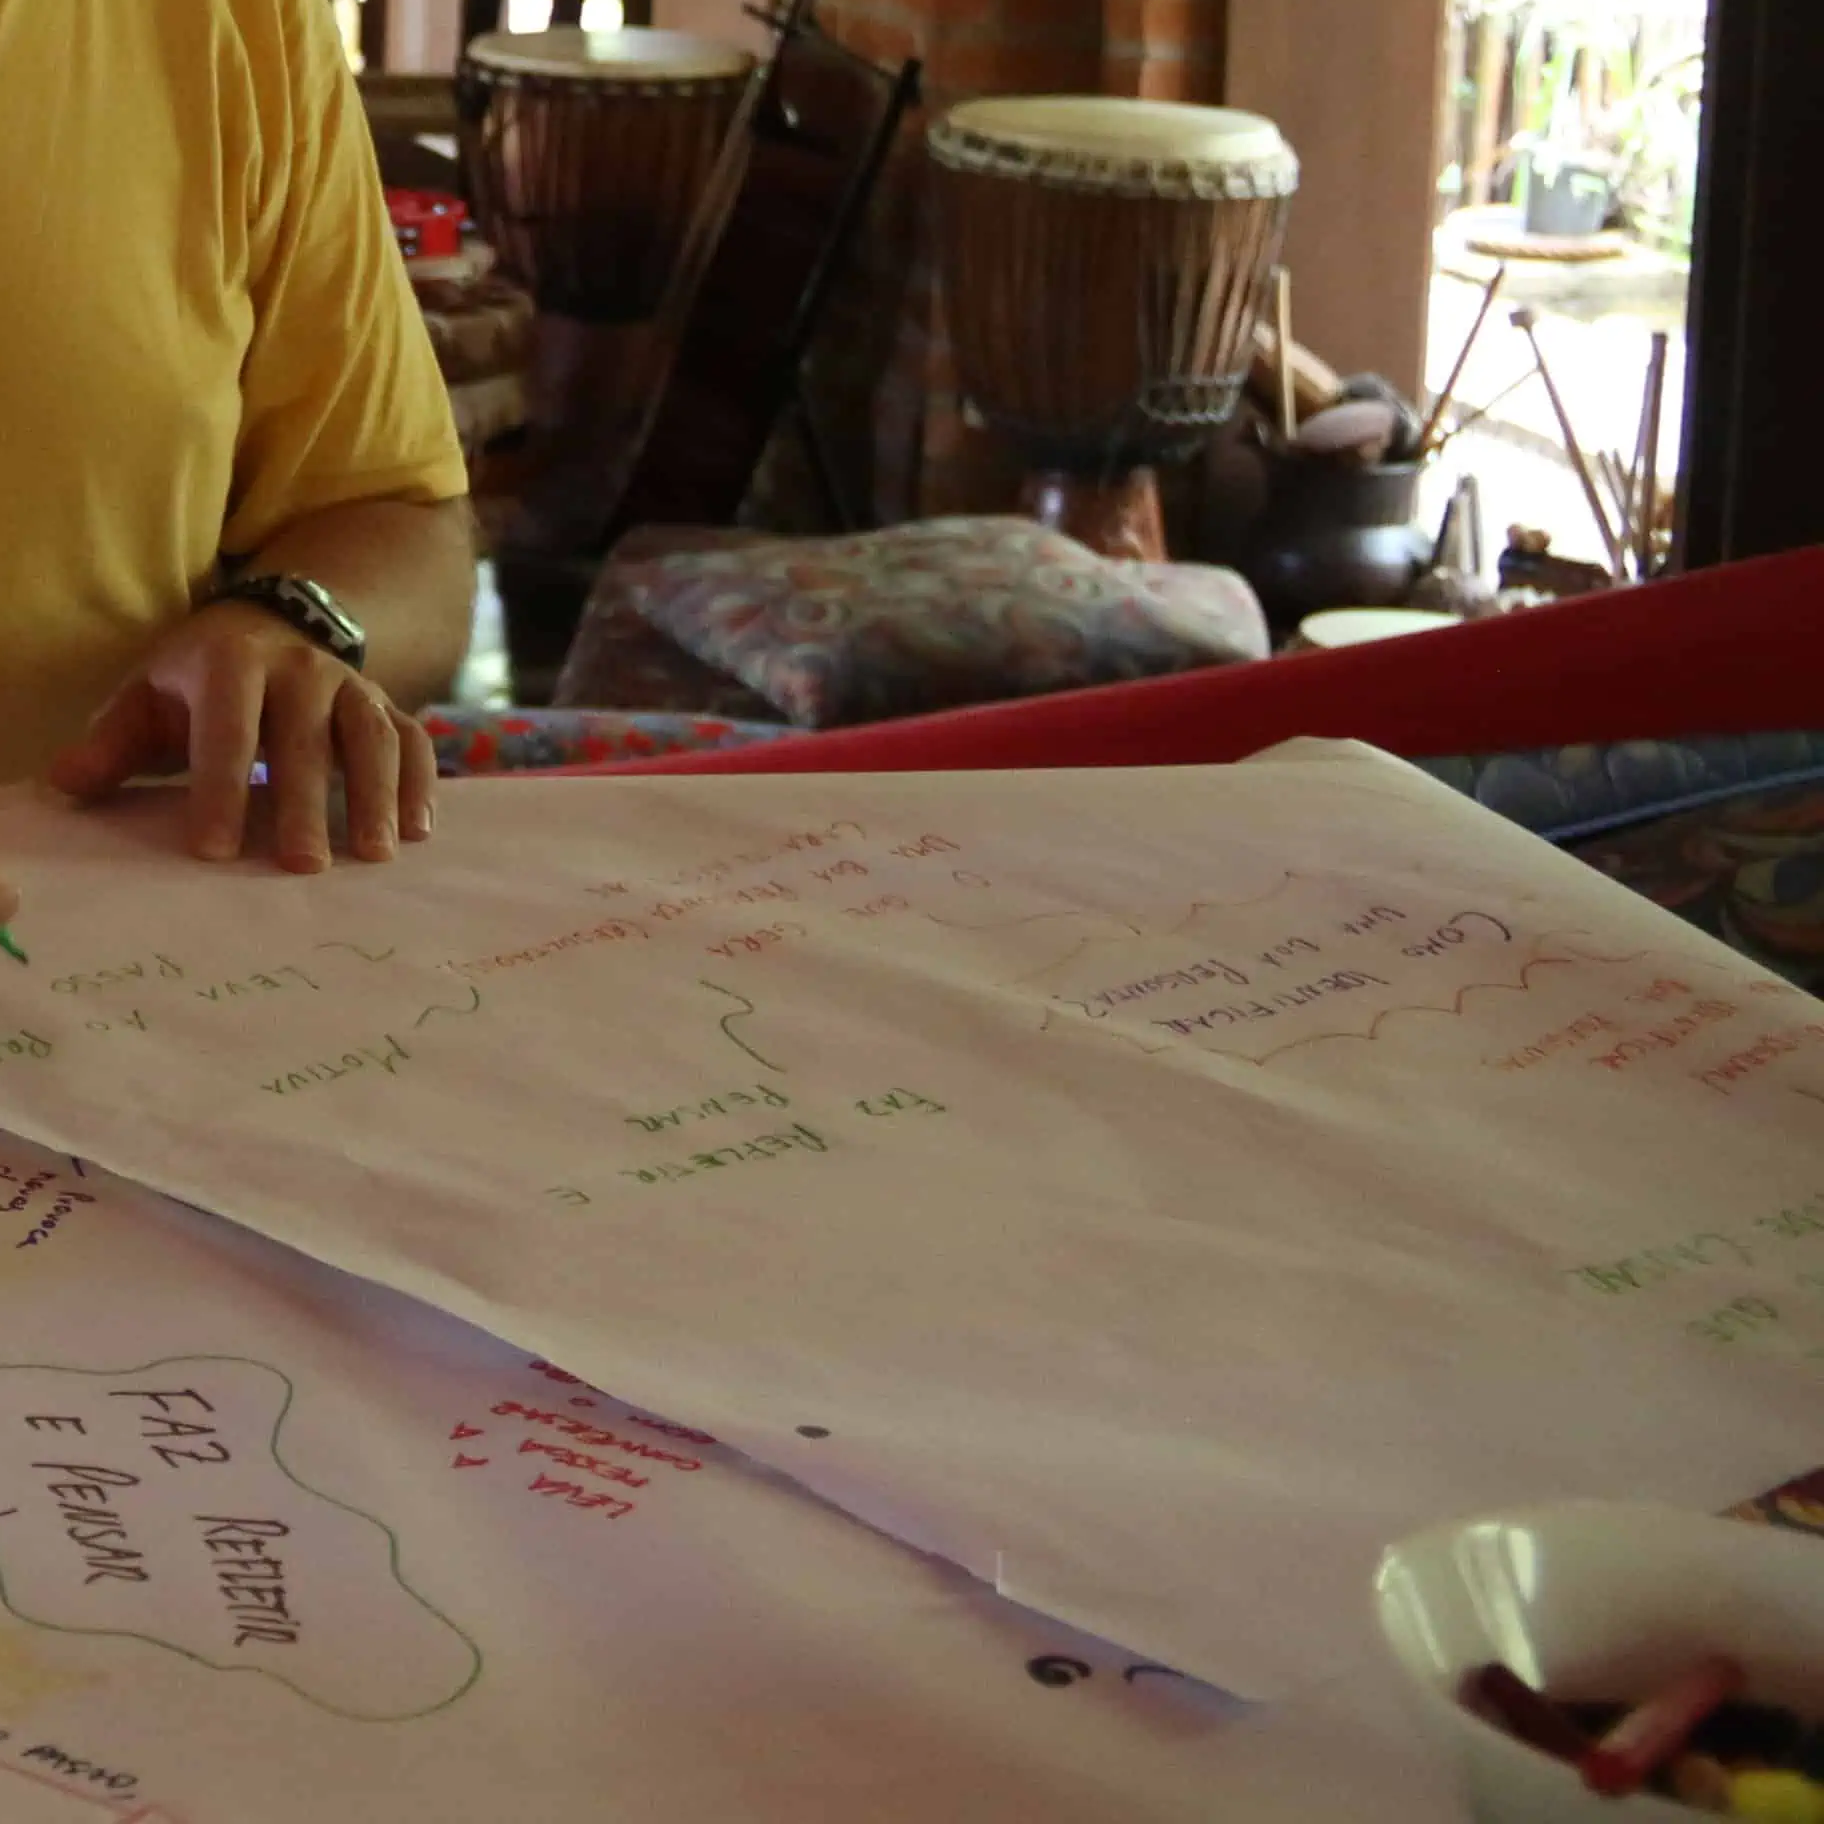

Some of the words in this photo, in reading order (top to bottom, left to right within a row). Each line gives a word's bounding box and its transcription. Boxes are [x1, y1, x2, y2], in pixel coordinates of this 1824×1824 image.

[24, 1415, 87, 1436] E
[108, 1387, 231, 1469] FAZ
[30, 1461, 150, 1587] PENSAR
[193, 1513, 302, 1648] REFLETIR
